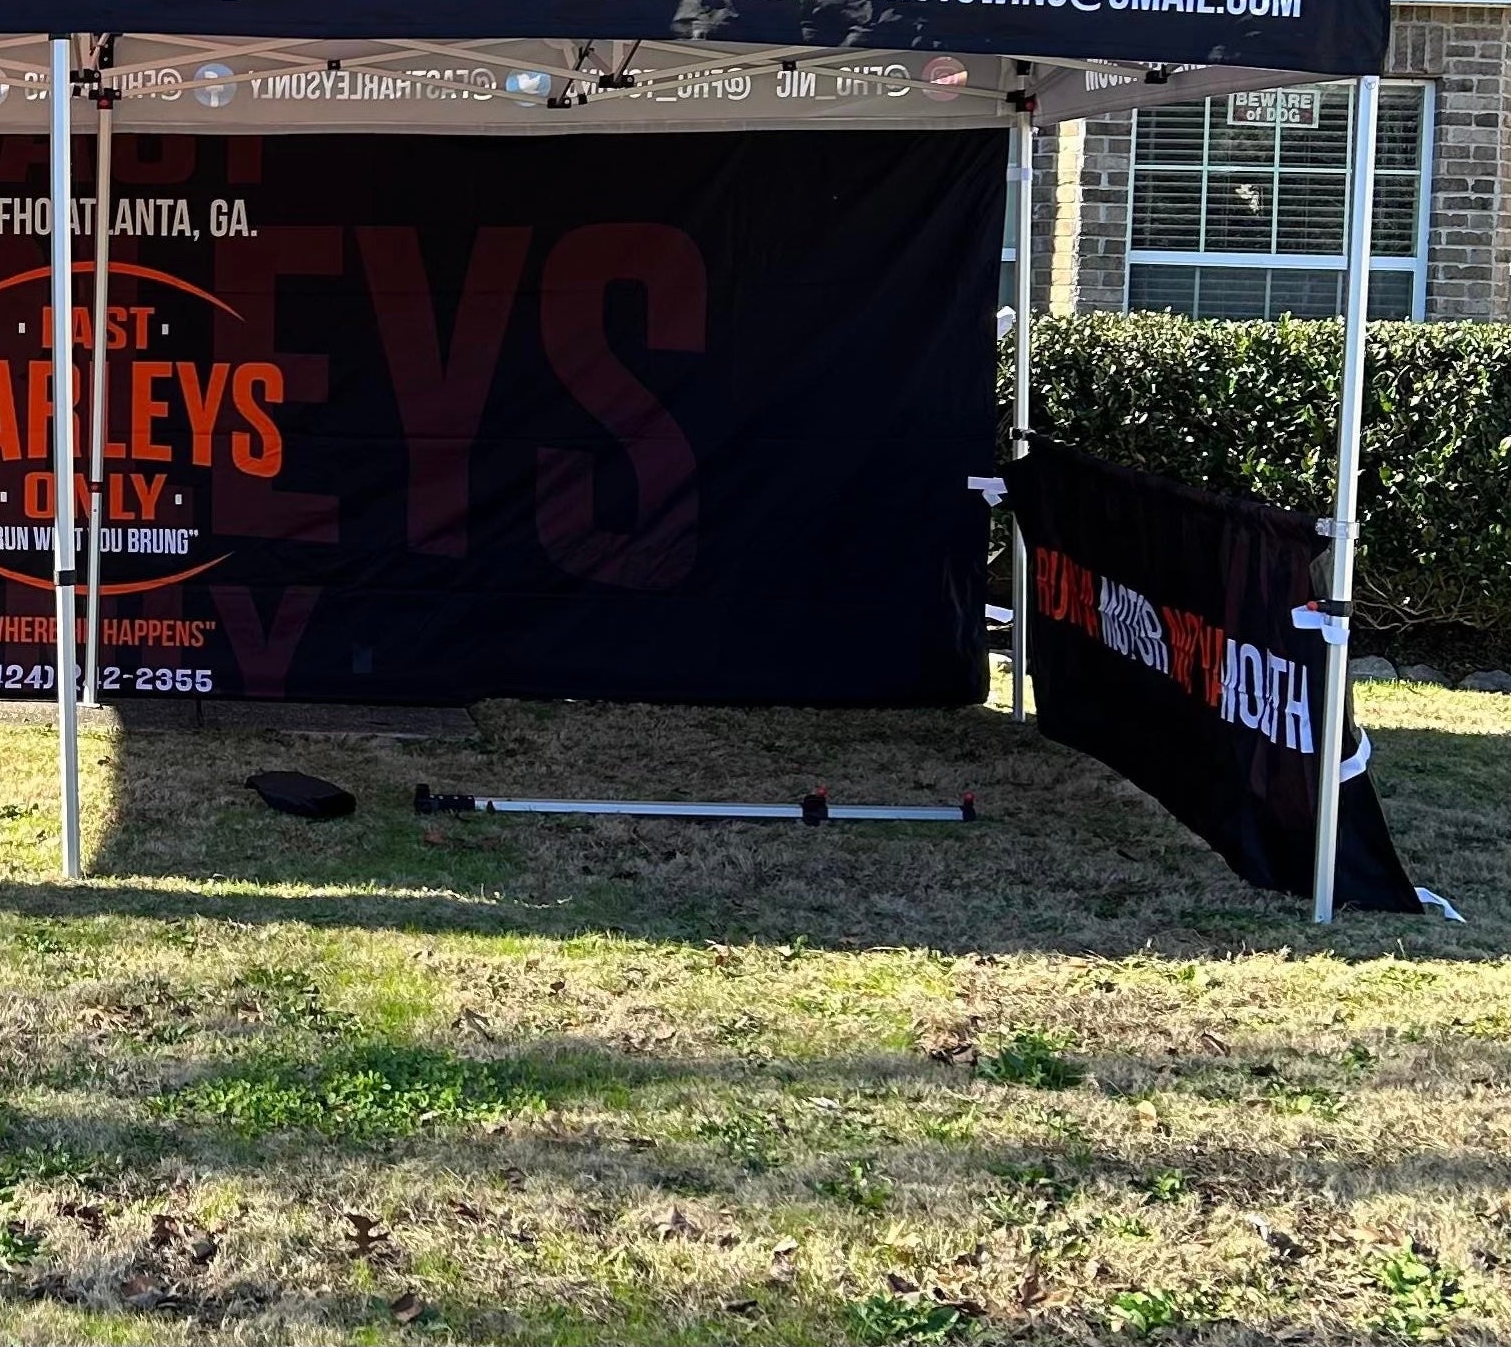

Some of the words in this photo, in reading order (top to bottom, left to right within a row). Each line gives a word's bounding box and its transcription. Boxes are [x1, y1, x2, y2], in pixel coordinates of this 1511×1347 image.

[1236, 92, 1312, 109] BEWARE
[1246, 107, 1262, 121] of
[1266, 108, 1300, 123] DOG
[69, 198, 200, 241] ATANTA,
[210, 199, 258, 237] GA.
[33, 527, 83, 552] WT
[88, 528, 123, 553] OU
[75, 663, 213, 693] 2-2355
